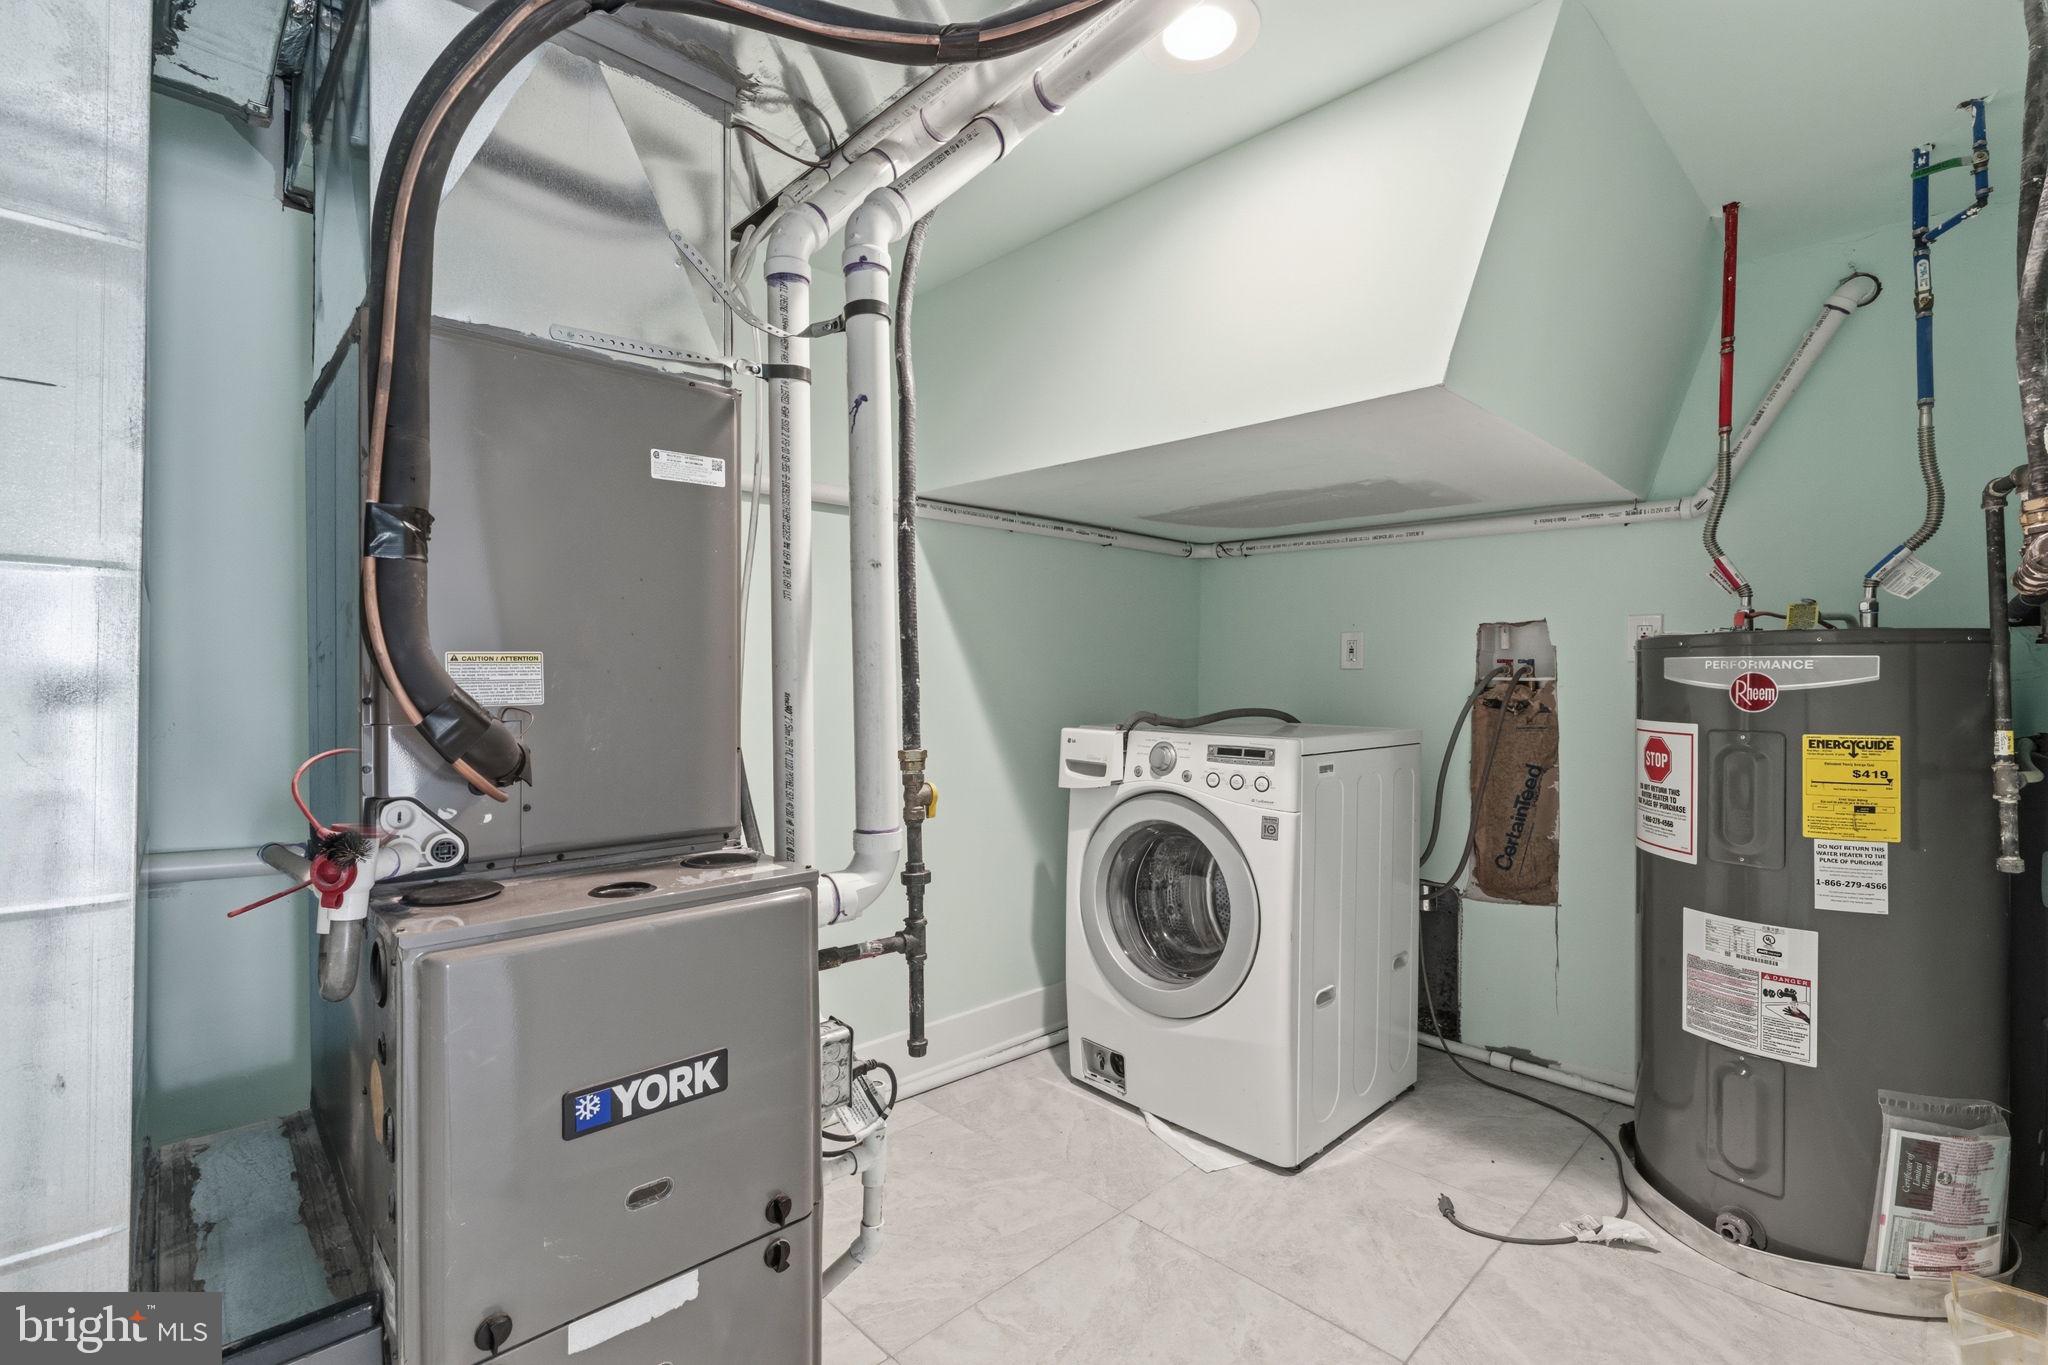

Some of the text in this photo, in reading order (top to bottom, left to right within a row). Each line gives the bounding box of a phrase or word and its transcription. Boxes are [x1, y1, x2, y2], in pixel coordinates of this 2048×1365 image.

[1705, 660, 1814, 670] PERFORMANCE
[1736, 673, 1775, 706] Rheem
[1808, 740, 1894, 752] ENERGYGUIDE
[1645, 751, 1668, 768] STOP
[1852, 769, 1889, 779] $419
[1659, 802, 1686, 813] PURCHASE
[1495, 763, 1543, 871] CertainTeed
[1816, 879, 1887, 890] 1-866-279-4566
[1772, 975, 1808, 985] DANGER
[612, 1055, 720, 1118] YORK
